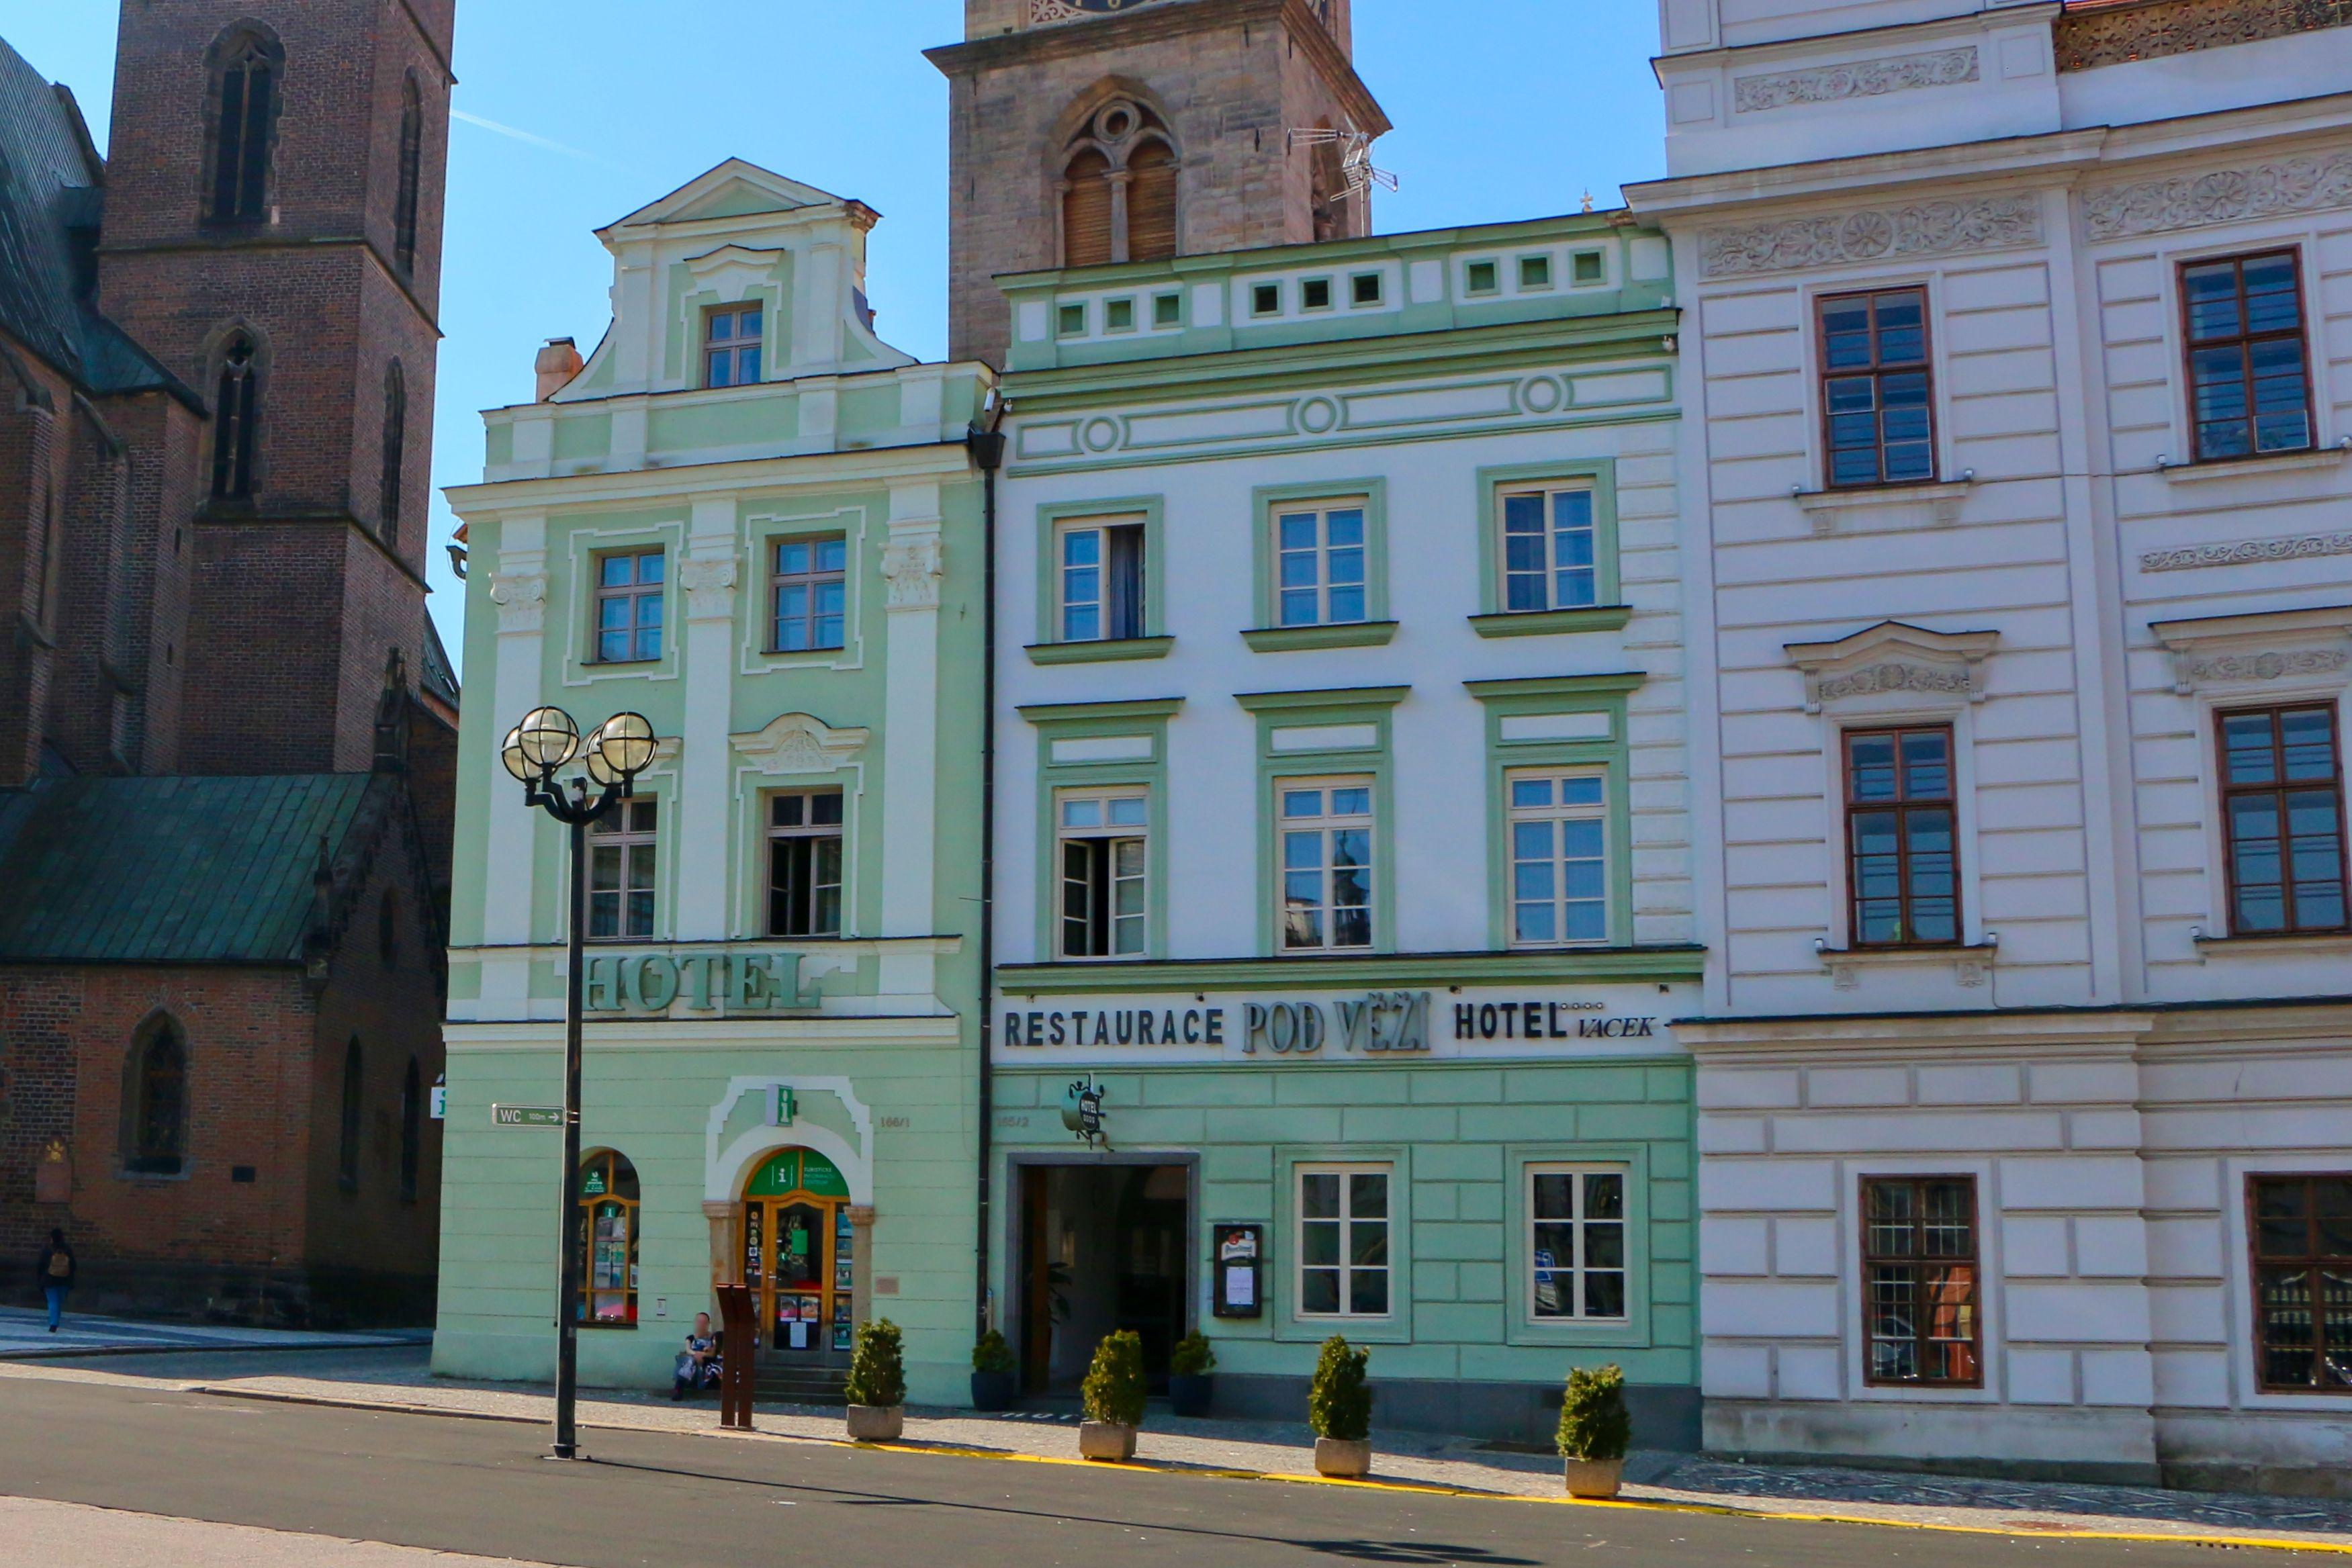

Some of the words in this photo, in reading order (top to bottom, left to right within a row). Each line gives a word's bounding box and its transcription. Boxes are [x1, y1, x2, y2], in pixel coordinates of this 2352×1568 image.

[582, 952, 822, 1011] HOTEL
[1005, 1009, 1223, 1046] RESTAURACE
[1242, 1001, 1324, 1053] POD
[1333, 991, 1431, 1052] VĚŽÍ
[1455, 1002, 1568, 1039] HOTEL
[1579, 1017, 1656, 1037] VACEK
[500, 1109, 521, 1122] WC
[1081, 1099, 1097, 1114] HOTEL
